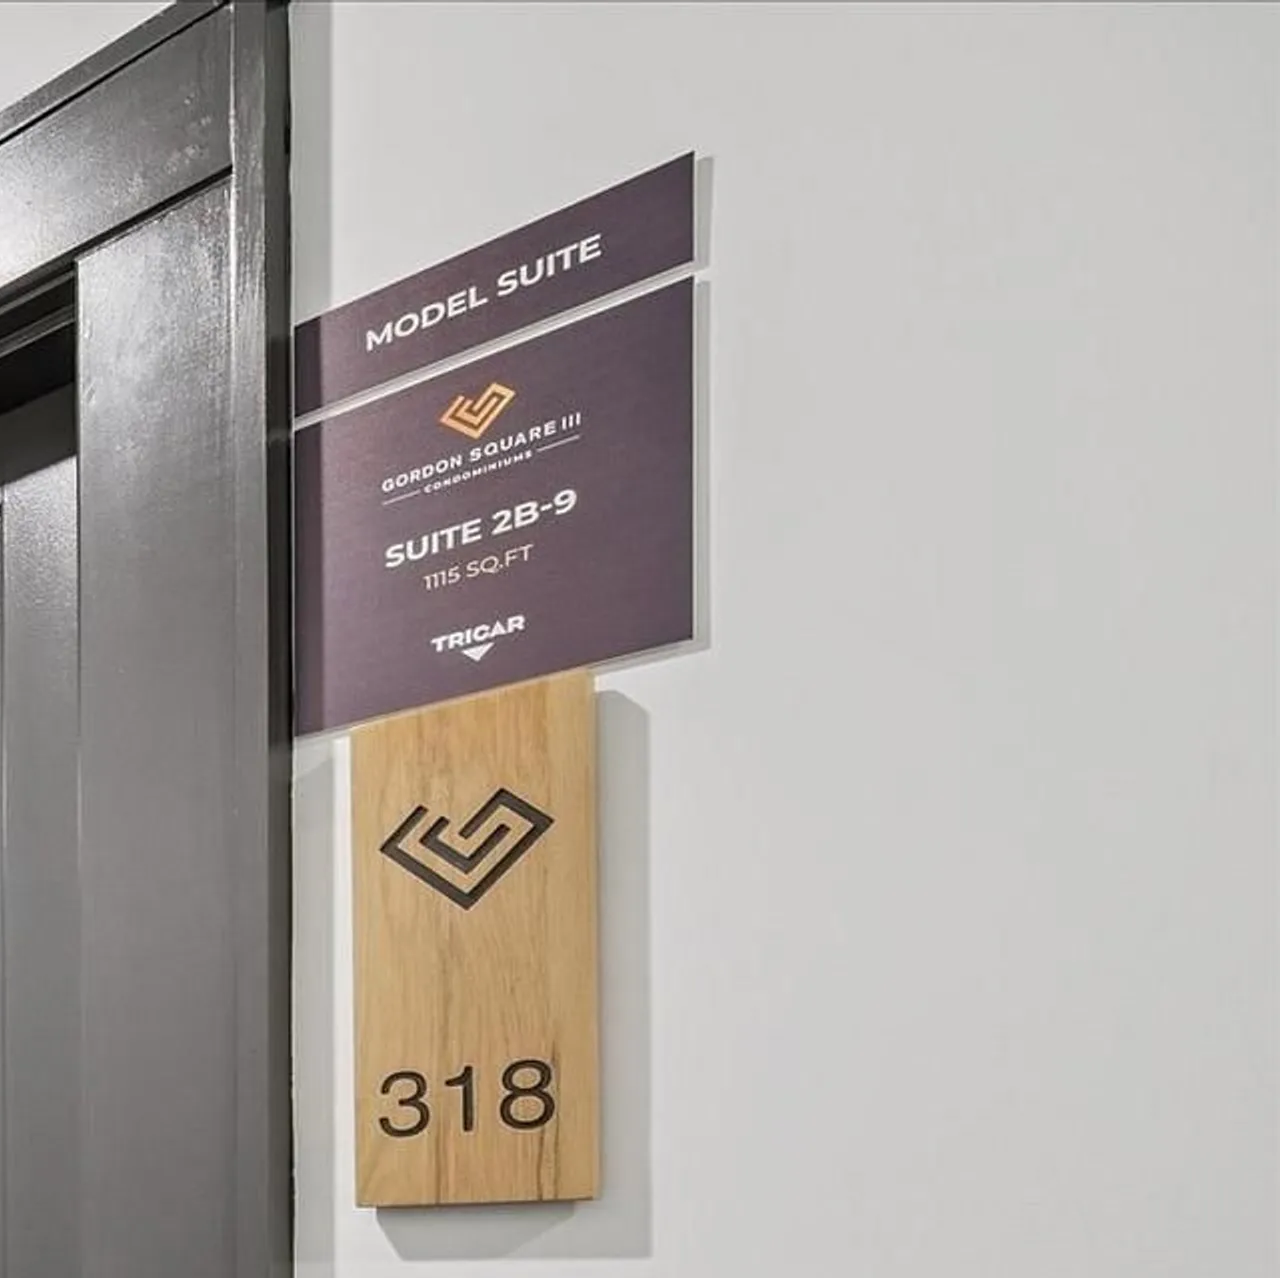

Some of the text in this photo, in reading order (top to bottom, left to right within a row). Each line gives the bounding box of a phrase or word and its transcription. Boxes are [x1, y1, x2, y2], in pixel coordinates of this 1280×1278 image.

[365, 233, 602, 352] MODEL SUITE
[381, 411, 582, 493] GORDON SQUARE III
[424, 450, 533, 493] CONDOMINIUMS
[384, 488, 578, 569] SUITE 2B-9
[423, 543, 535, 591] 1115 SQ.FT
[430, 614, 526, 653] TRICAR
[378, 1059, 556, 1138] 318
